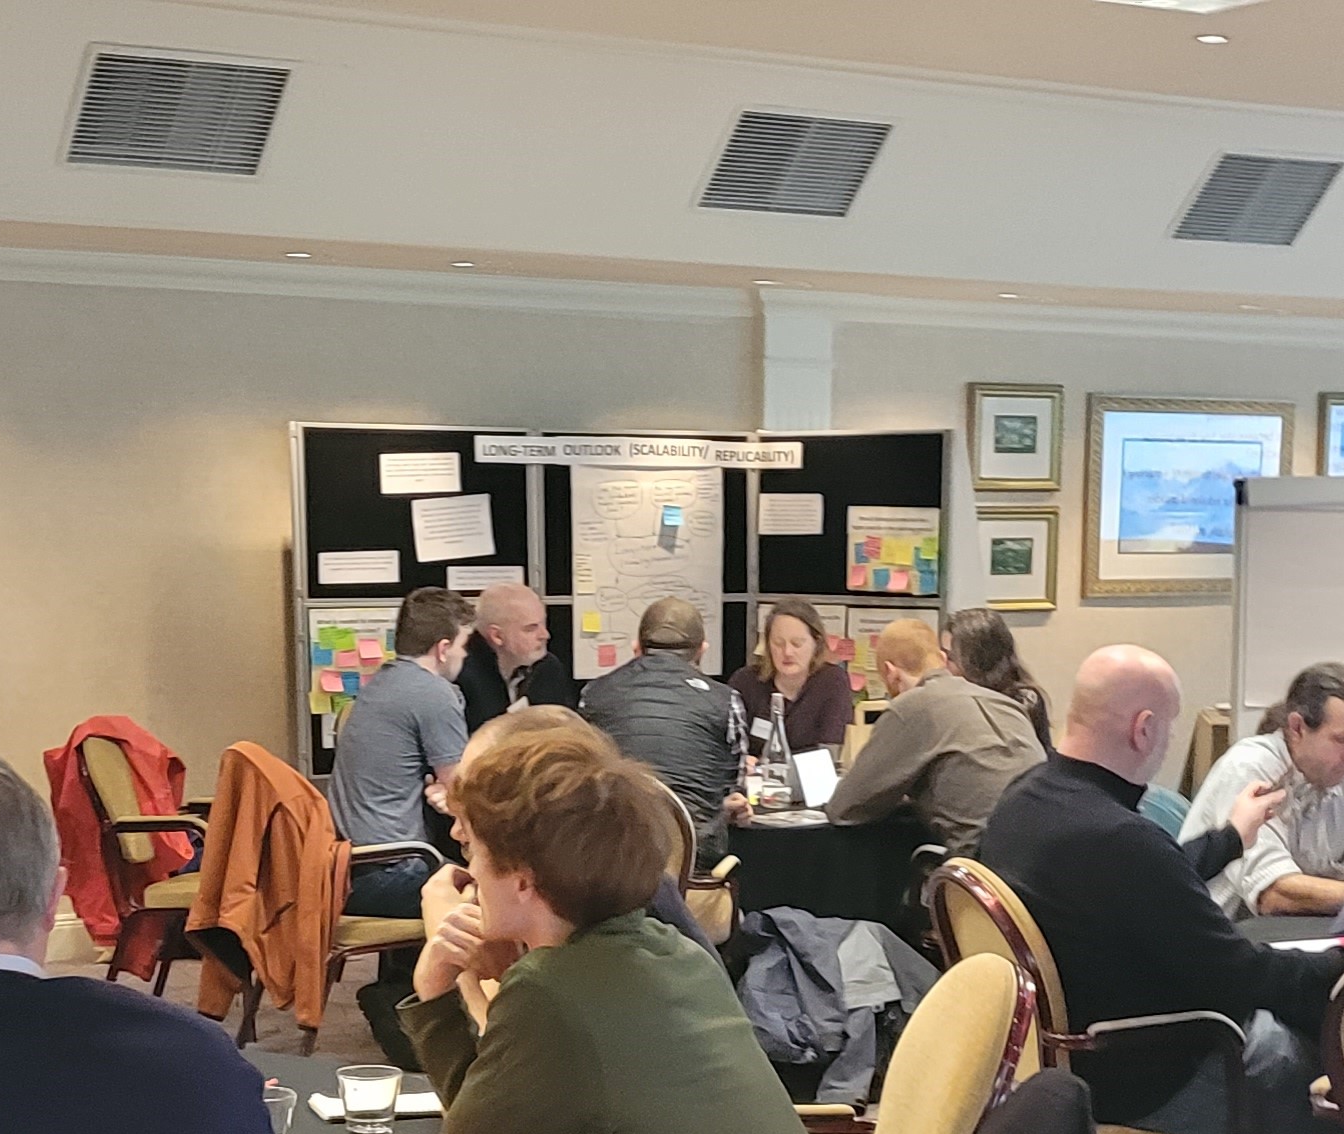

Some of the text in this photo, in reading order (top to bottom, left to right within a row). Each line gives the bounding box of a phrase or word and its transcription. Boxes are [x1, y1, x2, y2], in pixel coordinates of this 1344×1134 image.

[482, 444, 556, 457] LONG-TERM
[562, 444, 622, 456] OUTLOOK
[628, 443, 709, 460] (SCALABILITY/
